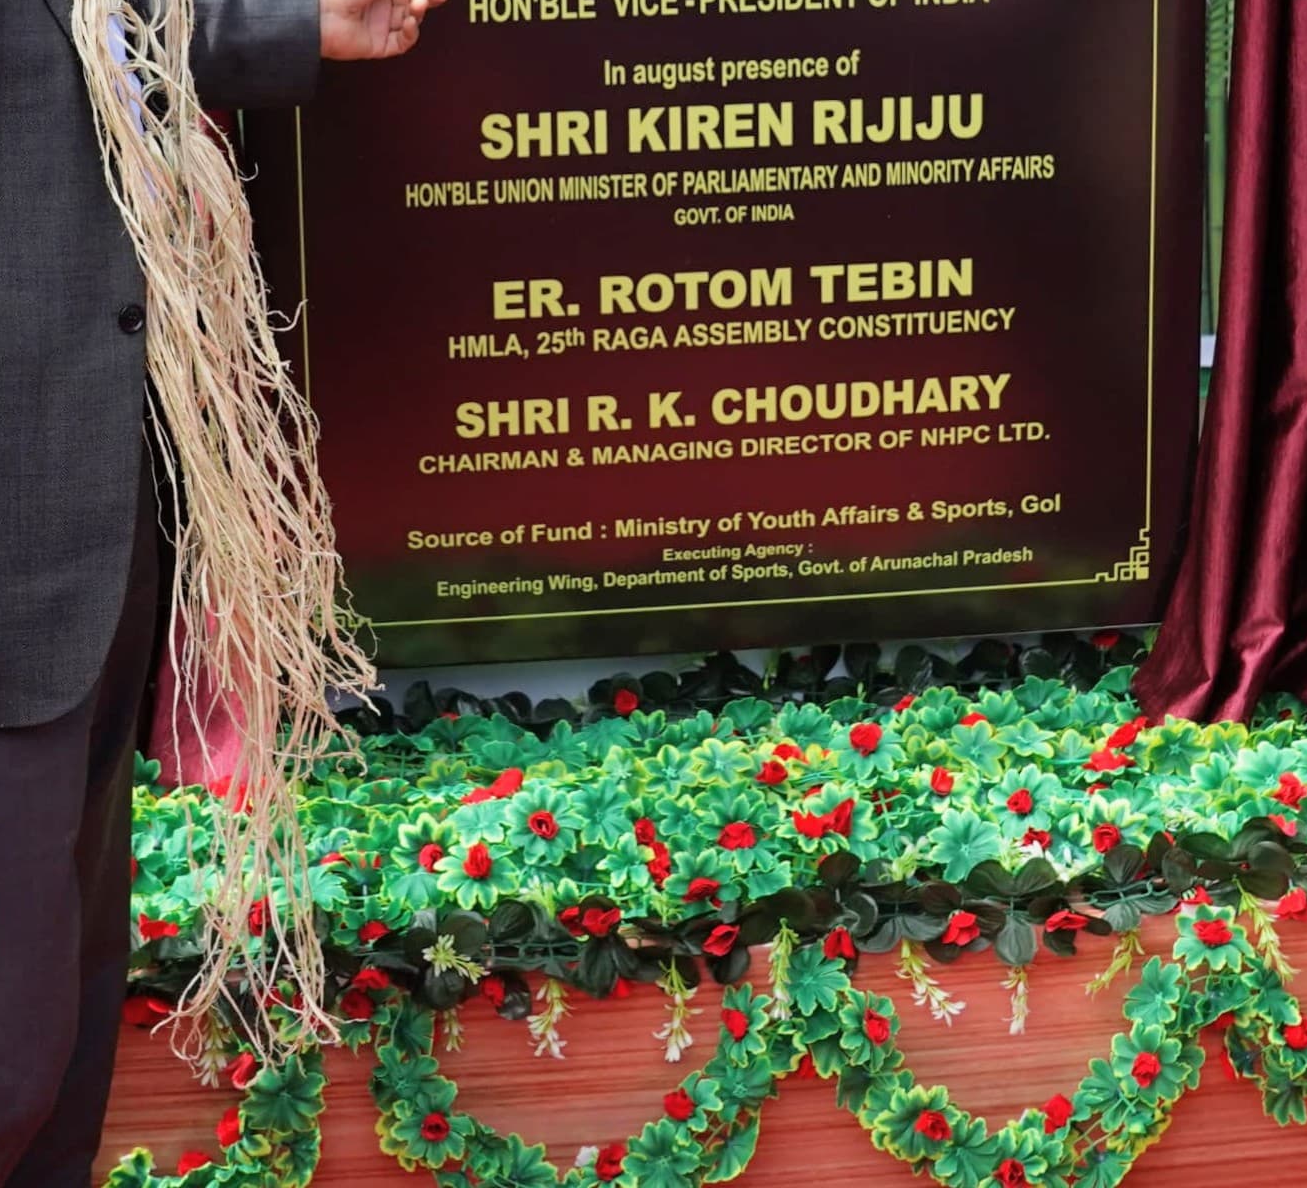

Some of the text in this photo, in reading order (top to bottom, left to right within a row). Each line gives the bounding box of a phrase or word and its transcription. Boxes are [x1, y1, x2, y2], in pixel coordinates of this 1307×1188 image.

[604, 49, 861, 90] In august presence of
[480, 93, 983, 160] SHRI KIREN RIJIJU
[405, 154, 1055, 207] HON'BLE UNION MINISTER OF PARLIAMENTARY AND MINORITY AFFAIRS
[674, 203, 795, 226] GOVT. OF INDIA
[493, 257, 973, 320] ER. ROTOM TEBIN
[448, 307, 1016, 359] HMLA, 25th RAGA ASSEMBLY CONSTITUENCY
[456, 373, 1011, 439] SHRI R. K. CHOUDHARY
[419, 421, 1050, 474] CHAIRMAN & MANAGING DIRECTOR OF NHPC LTD.
[408, 530, 494, 549] Source
[500, 524, 525, 545] of
[531, 522, 593, 543] Fund
[615, 518, 711, 538] Ministry
[717, 513, 742, 533] of
[747, 509, 816, 530] Youth
[821, 506, 900, 526] Affairs
[906, 502, 925, 521] &
[931, 499, 1014, 523] Sports,
[437, 547, 1034, 600] Engineering Wing, Department of Sports, Govt. of Arunachal Pradesh
[662, 546, 742, 562] Executing
[744, 543, 804, 559] Agency
